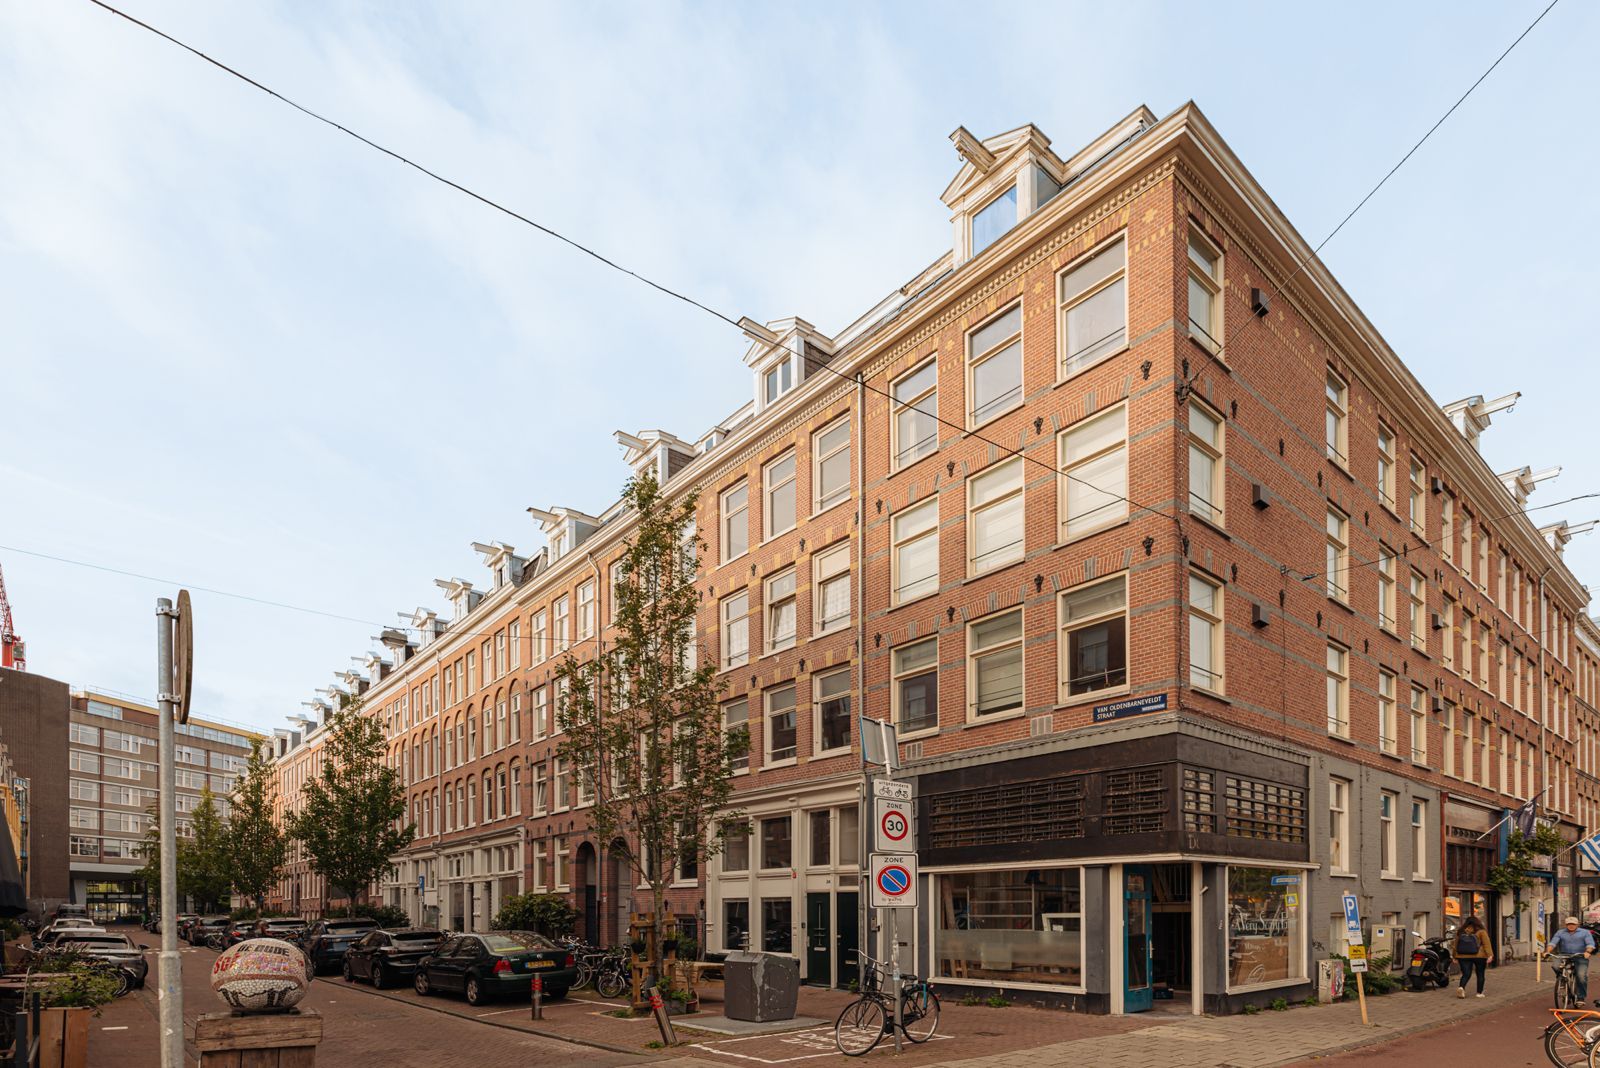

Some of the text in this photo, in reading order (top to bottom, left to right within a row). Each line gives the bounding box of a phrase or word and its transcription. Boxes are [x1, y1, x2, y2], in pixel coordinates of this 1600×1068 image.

[1097, 706, 1108, 714] VAN
[1109, 696, 1162, 710] OLDENBARNEVELDT
[1097, 711, 1115, 720] STRAAT
[887, 820, 904, 832] 30
[1346, 899, 1354, 917] P
